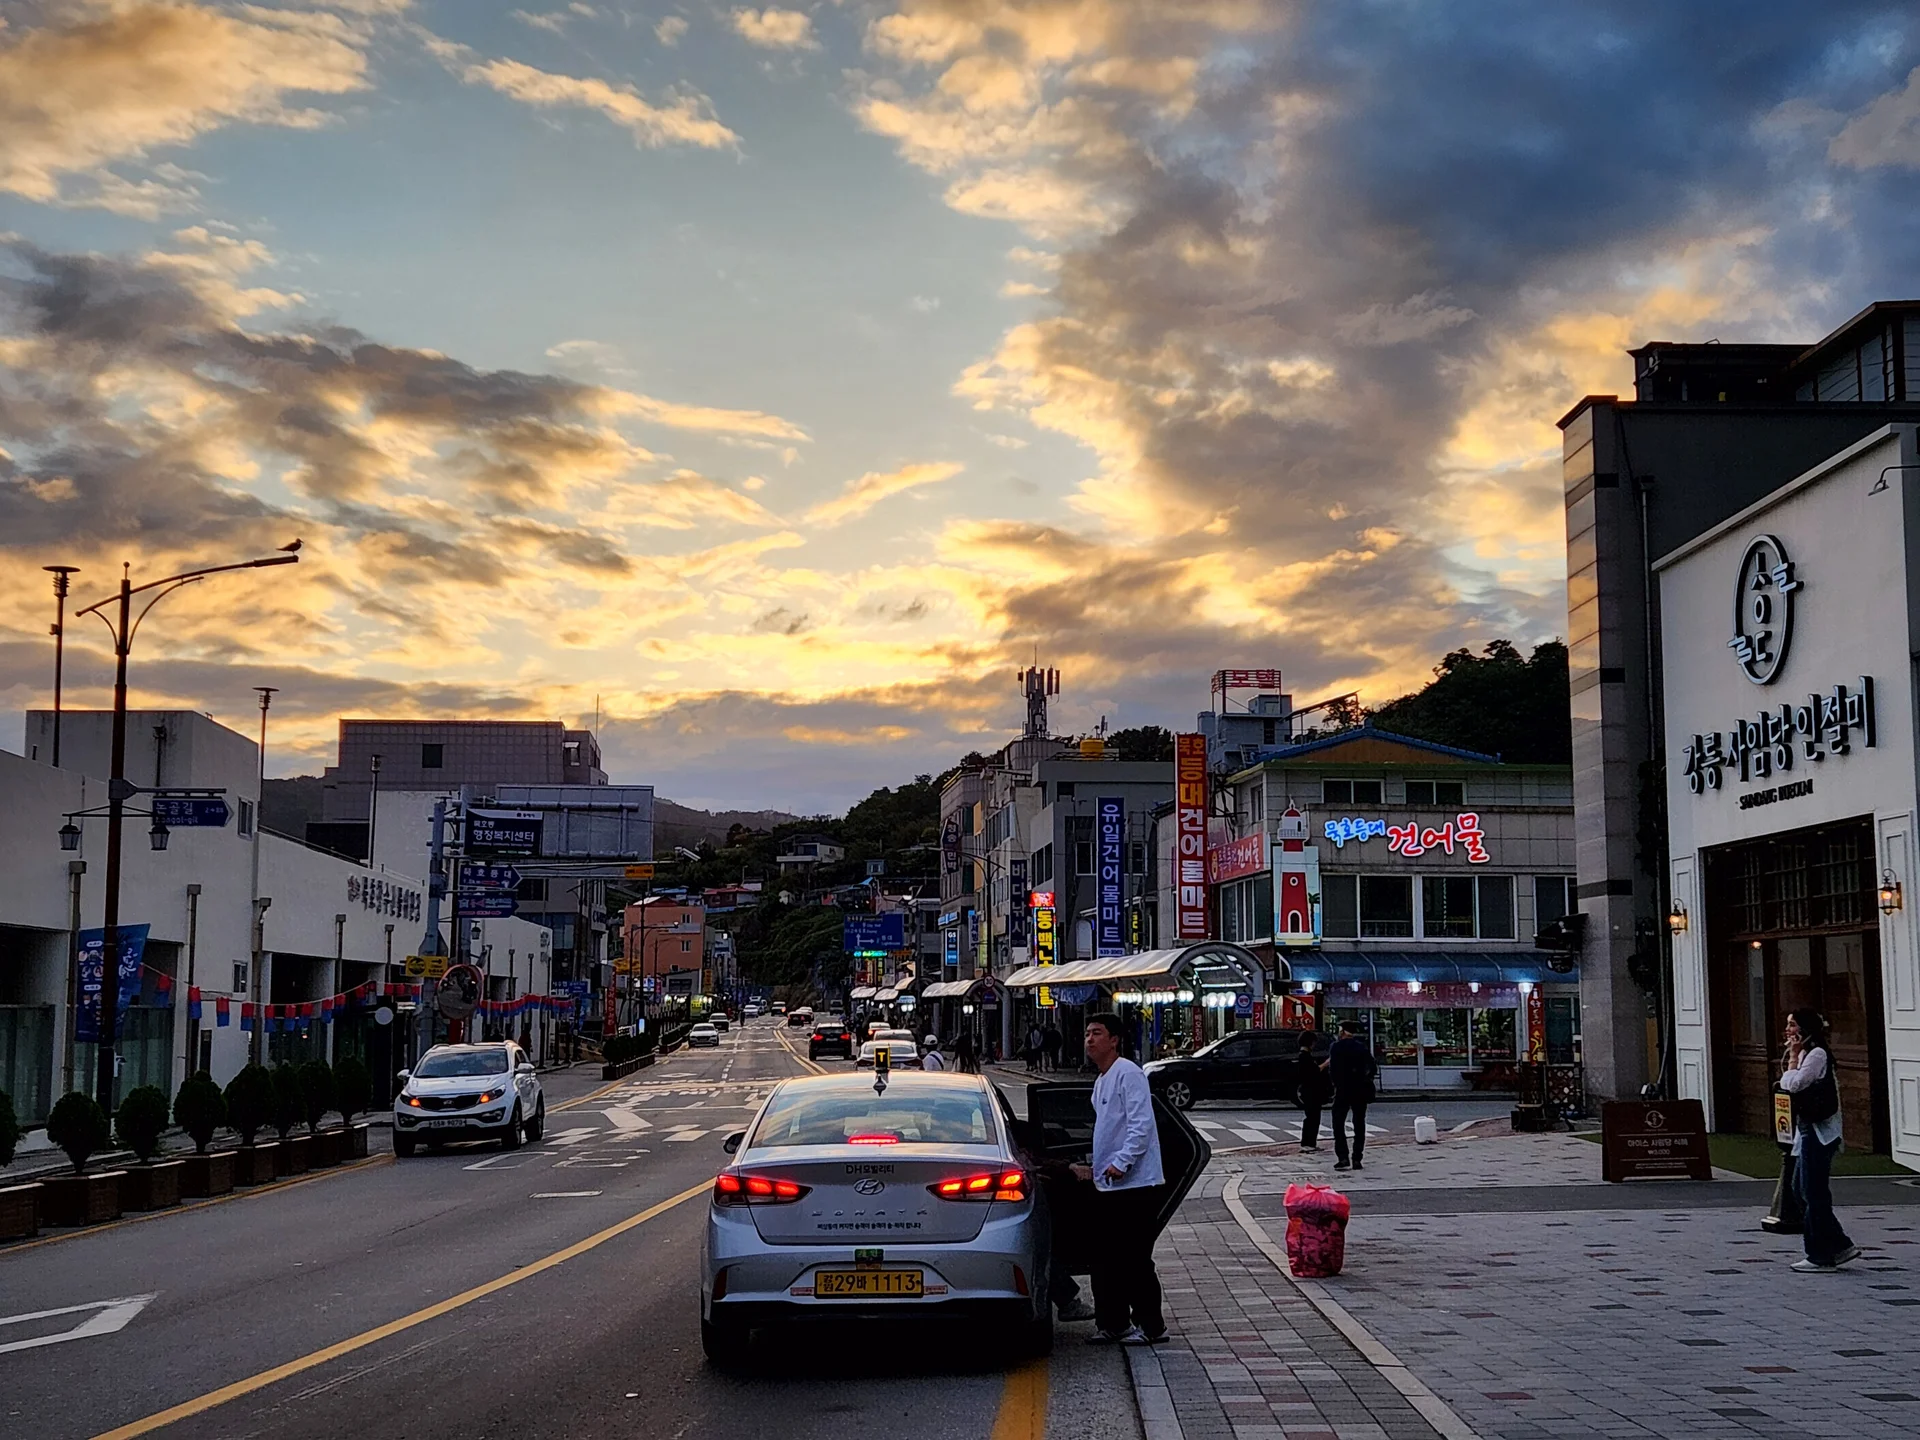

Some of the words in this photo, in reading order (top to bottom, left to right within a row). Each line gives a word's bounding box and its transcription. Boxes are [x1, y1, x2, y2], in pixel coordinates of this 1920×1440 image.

[155, 801, 194, 816] 논골길
[473, 829, 535, 842] 행정복지센터
[1324, 817, 1386, 848] 묵호등대
[1386, 812, 1490, 863] 건어물
[1101, 803, 1121, 943] 유일건어물마트
[877, 1051, 886, 1063] T
[1627, 1139, 1650, 1148] 아이스
[1650, 1138, 1673, 1147] 사임당
[845, 1164, 895, 1174] DH모빌리티
[834, 1274, 867, 1292] 29바
[871, 1274, 916, 1292] 1113
